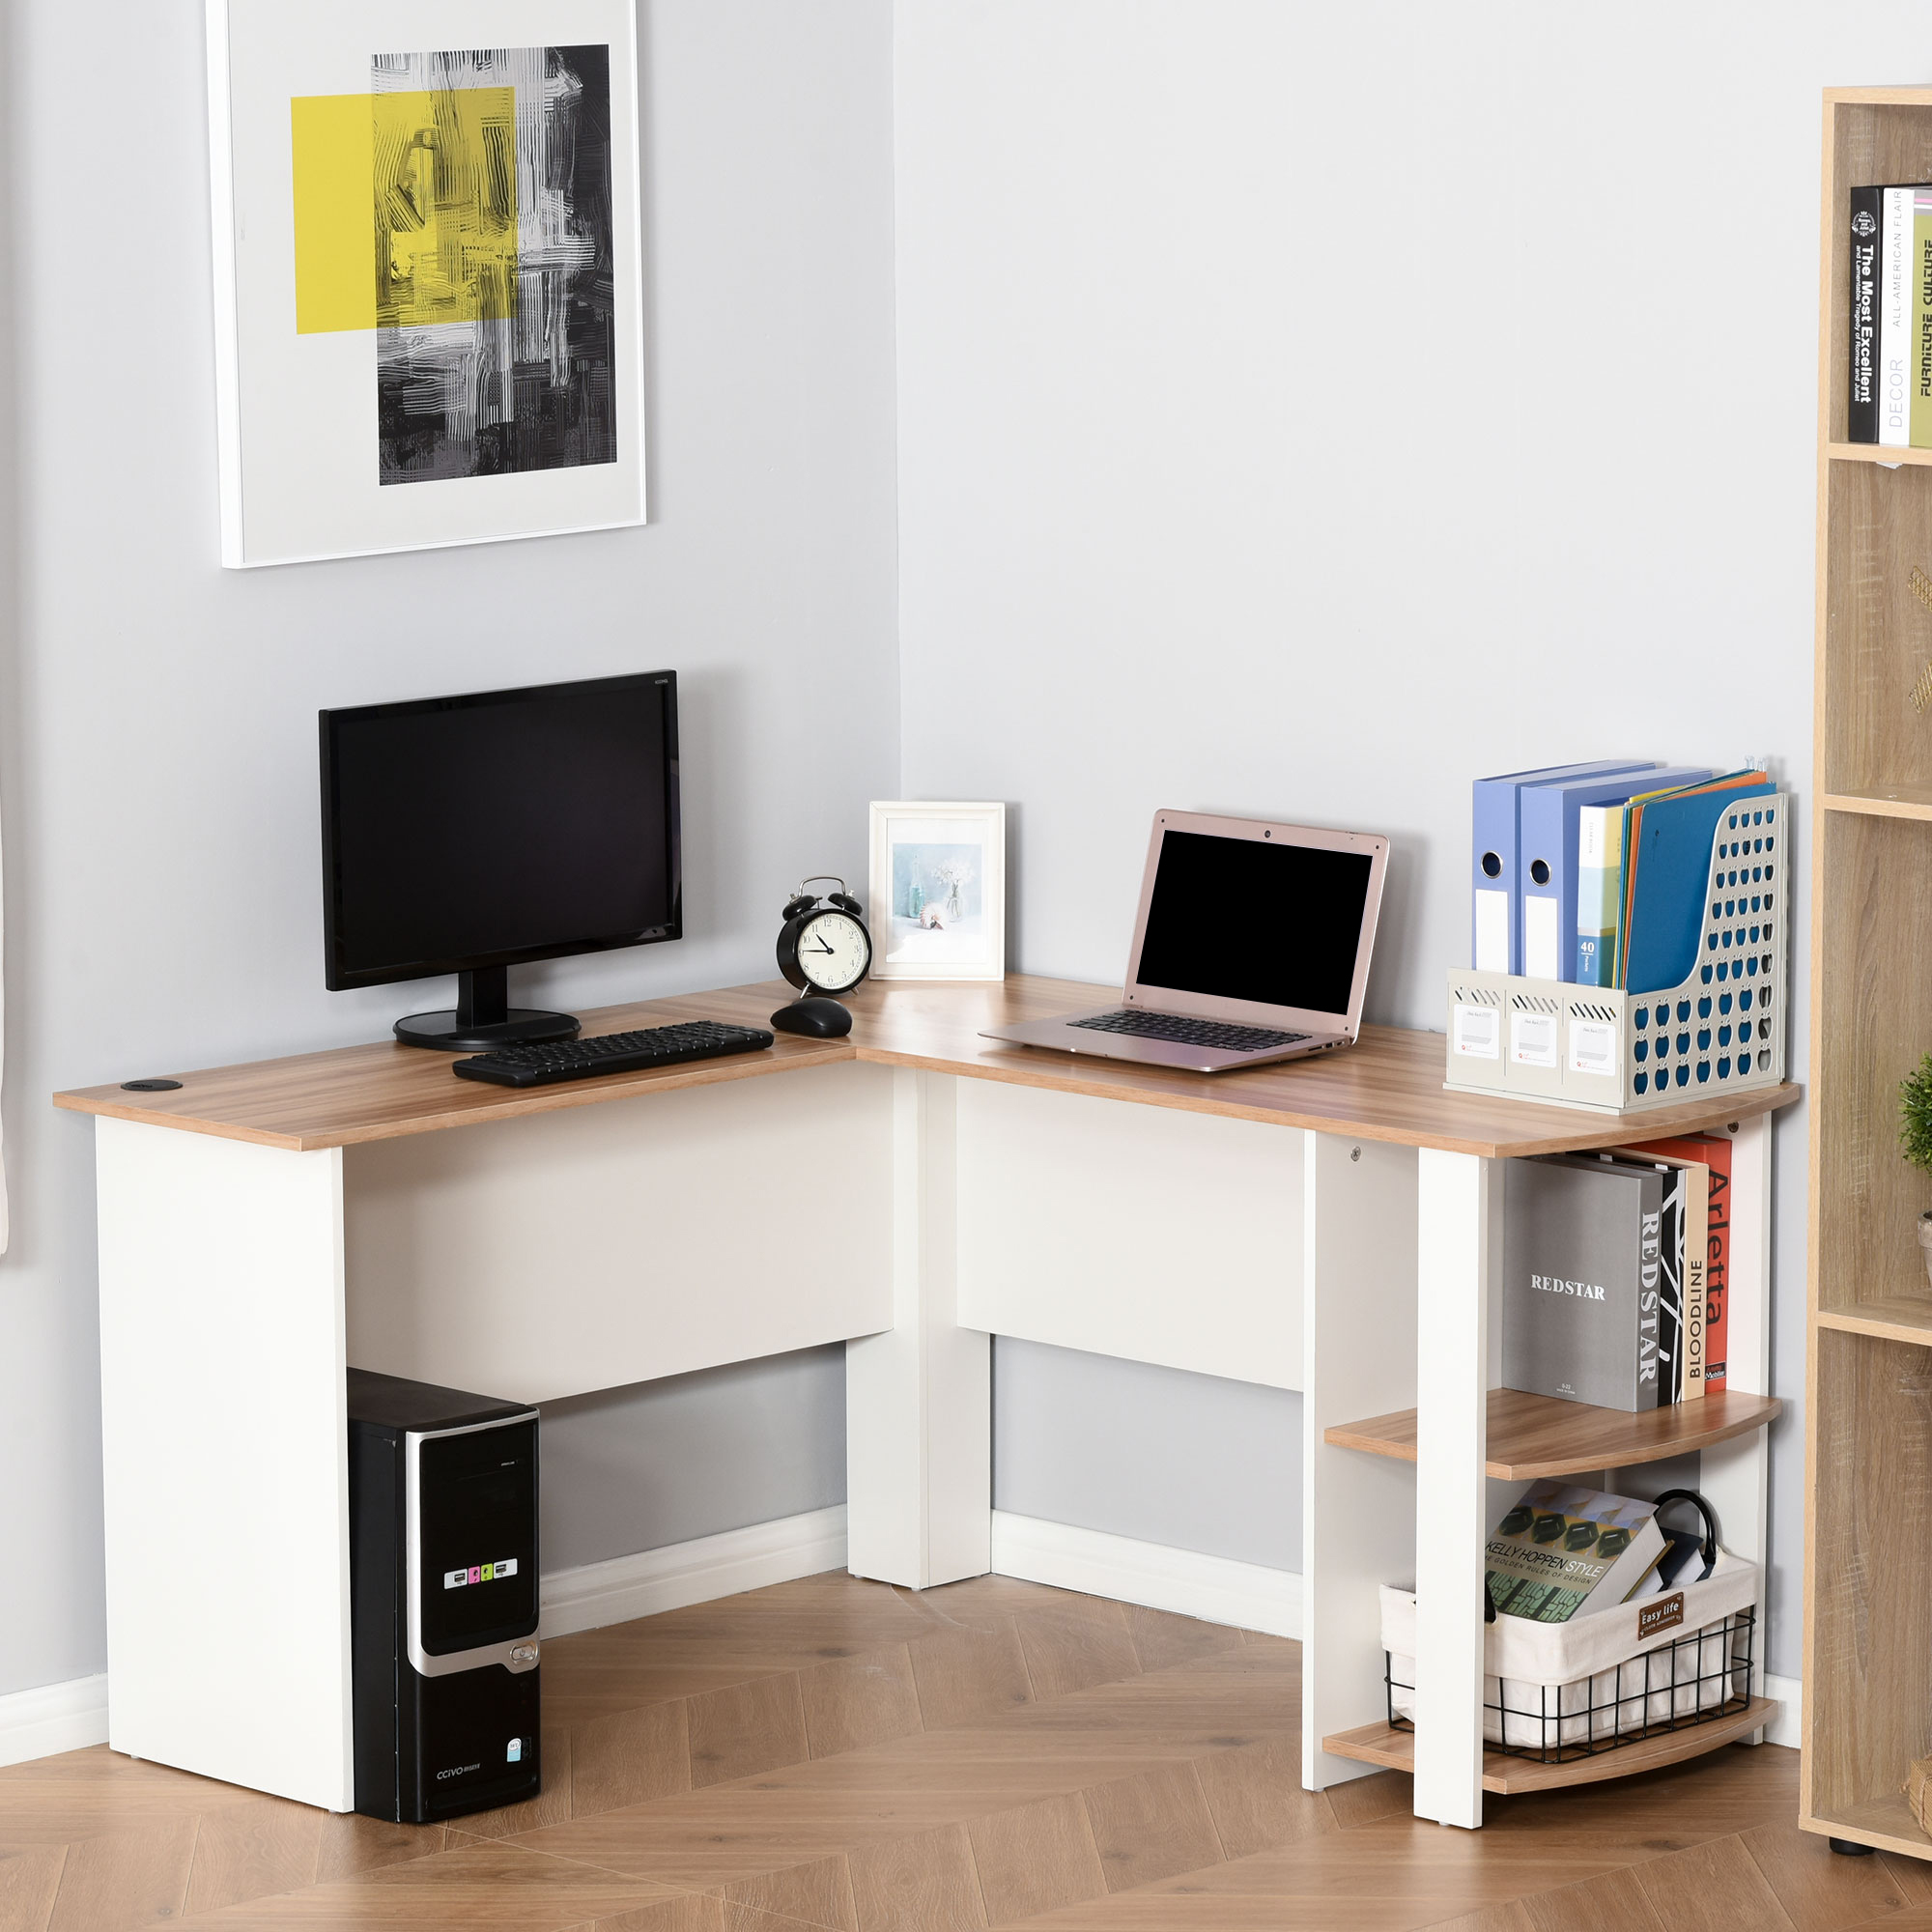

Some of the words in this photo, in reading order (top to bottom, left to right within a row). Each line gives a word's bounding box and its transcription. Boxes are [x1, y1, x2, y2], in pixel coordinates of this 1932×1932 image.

[1893, 190, 1902, 227] FLAIR
[1861, 244, 1874, 276] The
[1892, 233, 1901, 327] ALL-AMERICAN
[1861, 280, 1873, 322] Most
[1860, 326, 1873, 404] Excellent
[1889, 359, 1903, 428] DECOR
[1580, 941, 1595, 952] 40
[1707, 1169, 1729, 1325] Arletta
[1530, 1274, 1605, 1301] REDSTAR
[1639, 1209, 1660, 1384] REDSTAR
[1689, 1260, 1702, 1379] BLOODLINE
[1485, 1541, 1522, 1557] KELLY
[1518, 1548, 1569, 1570] HOPPEN
[1565, 1560, 1605, 1577] STYLE
[1493, 1556, 1524, 1570] GOLDEN
[1525, 1565, 1551, 1577] RULES
[1563, 1574, 1593, 1585] DESIGN
[1641, 1609, 1662, 1625] Easy
[1662, 1602, 1679, 1615] life
